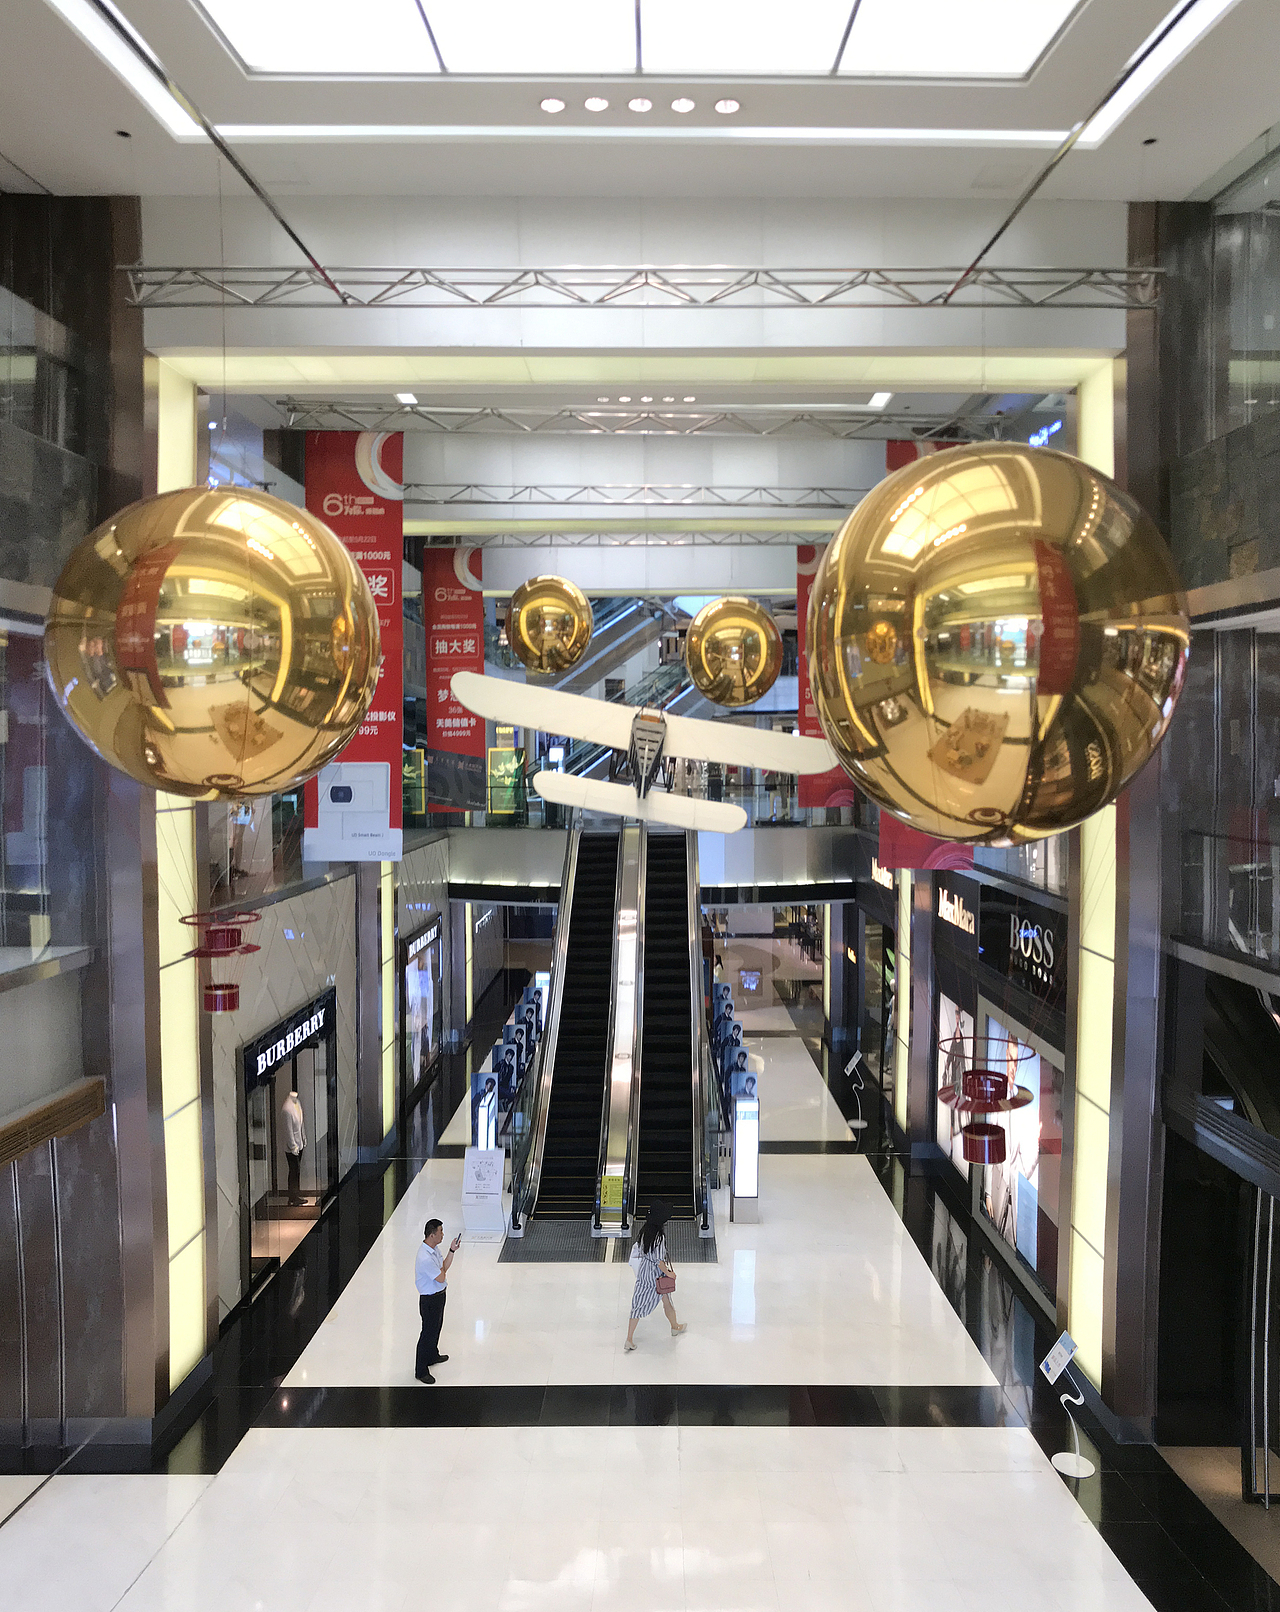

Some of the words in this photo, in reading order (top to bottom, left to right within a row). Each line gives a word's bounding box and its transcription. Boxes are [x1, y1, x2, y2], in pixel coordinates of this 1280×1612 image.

[435, 638, 476, 655] 抽大奖
[938, 887, 975, 935] MaxMara
[1009, 913, 1054, 969] BOSS
[256, 1007, 326, 1076] BURBERRY
